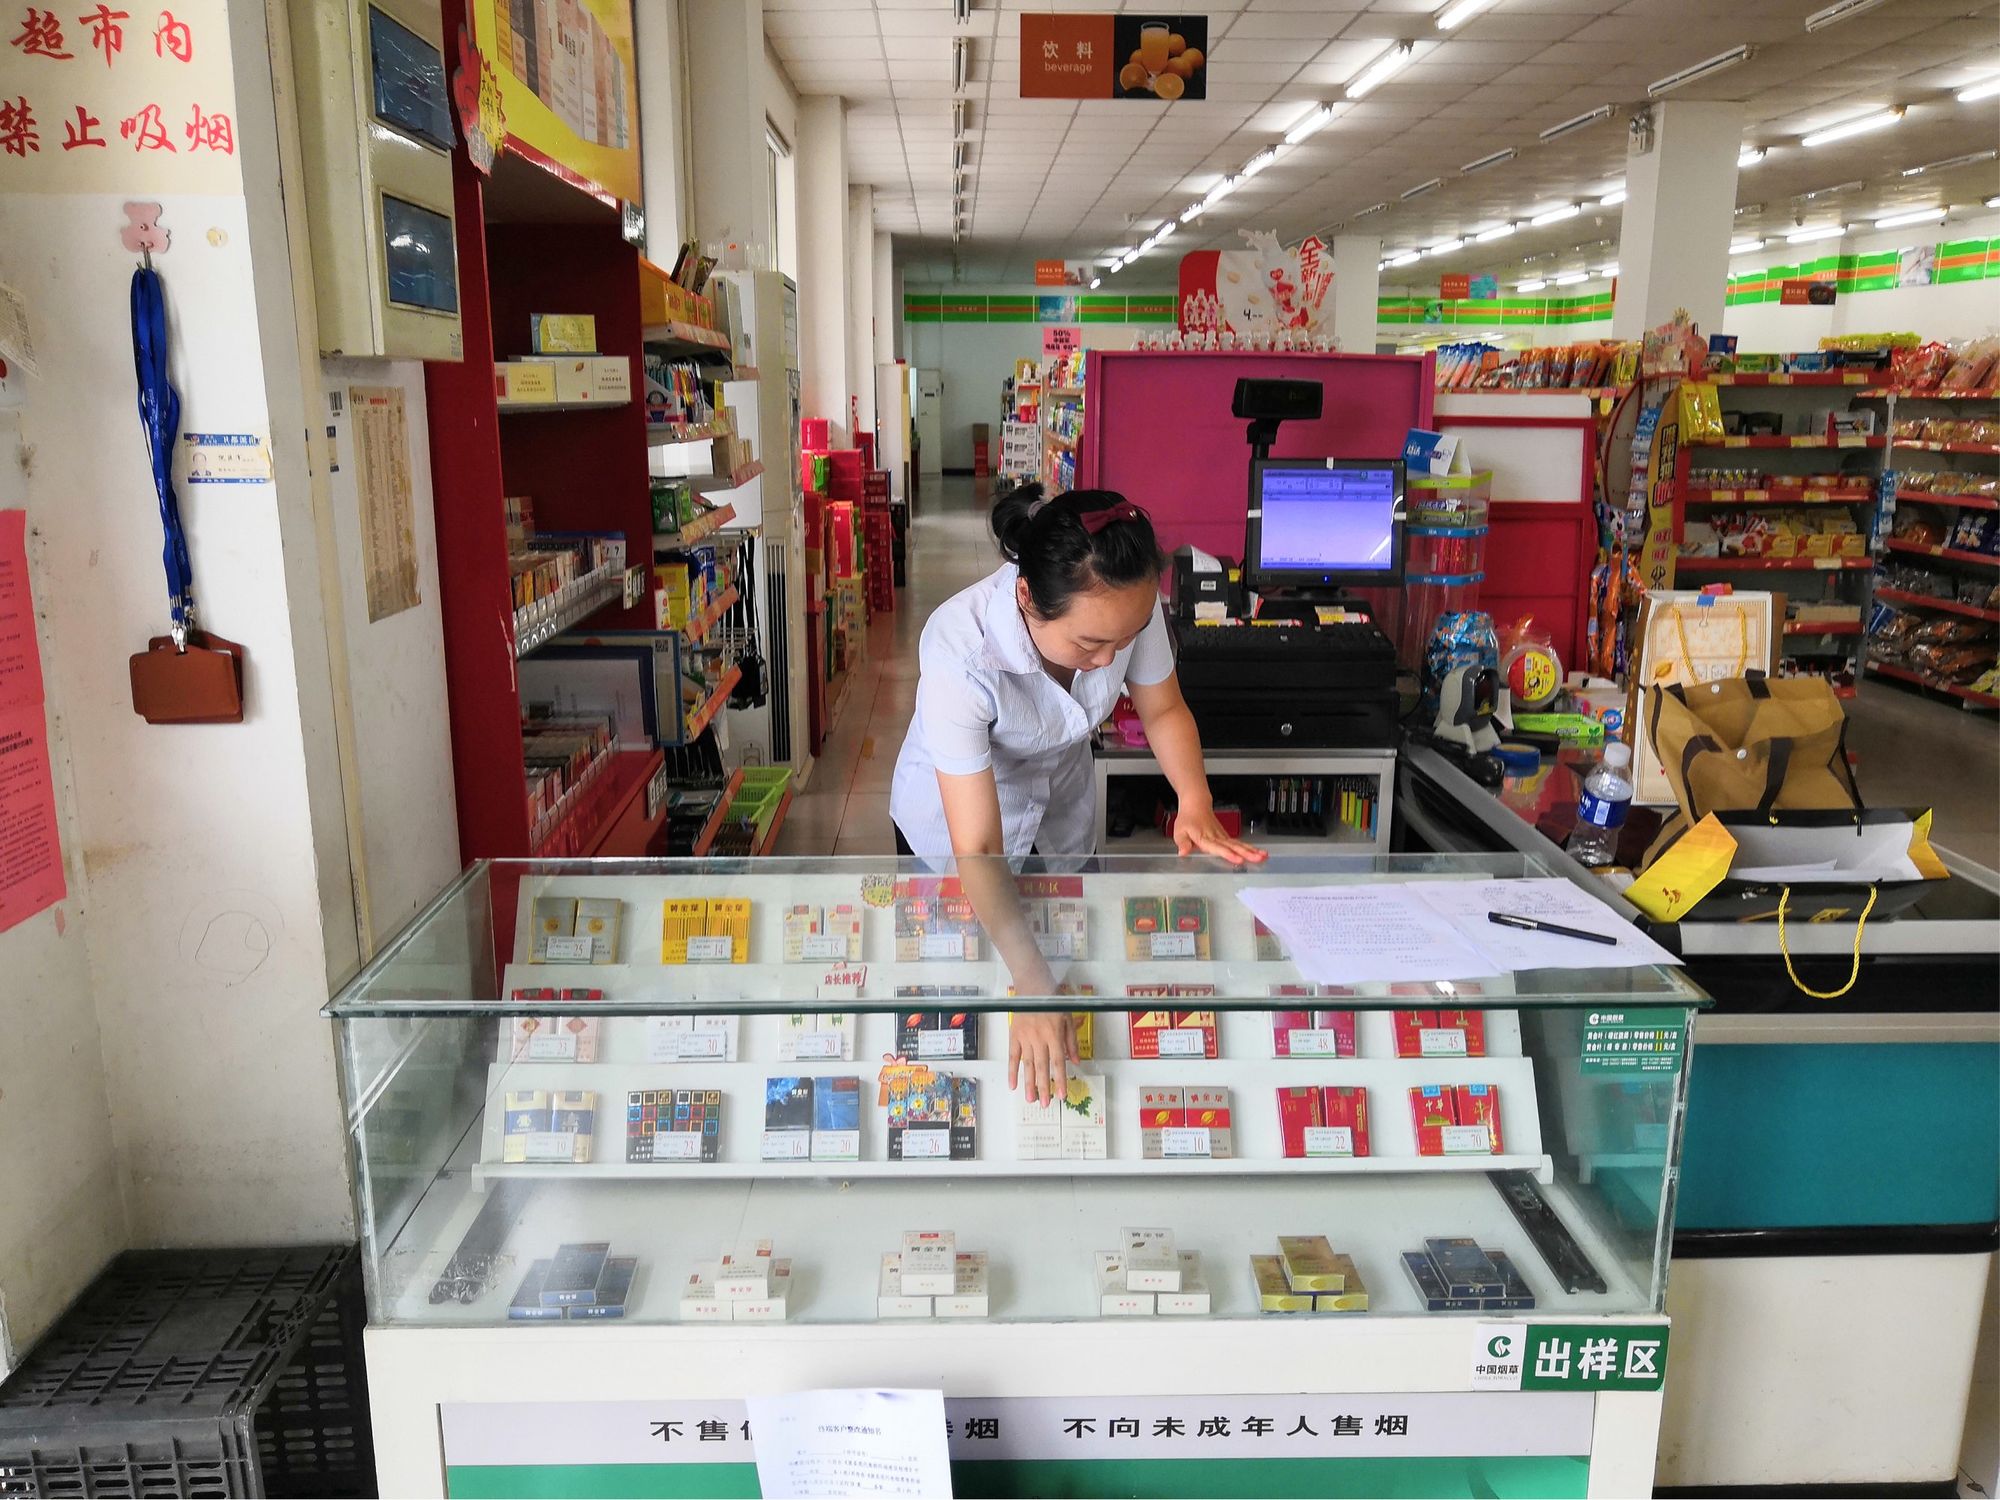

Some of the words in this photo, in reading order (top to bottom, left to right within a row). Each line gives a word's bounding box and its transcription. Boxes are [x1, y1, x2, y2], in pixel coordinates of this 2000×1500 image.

[10, 3, 194, 68] 超市内
[1043, 40, 1093, 59] 饮料
[1045, 62, 1092, 74] beverage
[0, 95, 235, 159] 禁止吸烟
[714, 943, 724, 956] 14
[825, 1039, 836, 1054] 20
[947, 1037, 957, 1052] 22
[1188, 1037, 1196, 1051] 11
[1317, 1038, 1329, 1051] 48
[1448, 1036, 1459, 1049] 45
[683, 1139, 695, 1156] 23
[791, 1139, 802, 1155] 16
[840, 1138, 851, 1153] 20
[928, 1138, 940, 1154] 26
[1193, 1136, 1204, 1153] 10
[1334, 1135, 1346, 1149] 22
[1471, 1134, 1482, 1148] 70
[1534, 1337, 1662, 1380] 出样区
[1475, 1364, 1519, 1375] 中国烟草
[1063, 1414, 1410, 1438] 不向未成年人售烟
